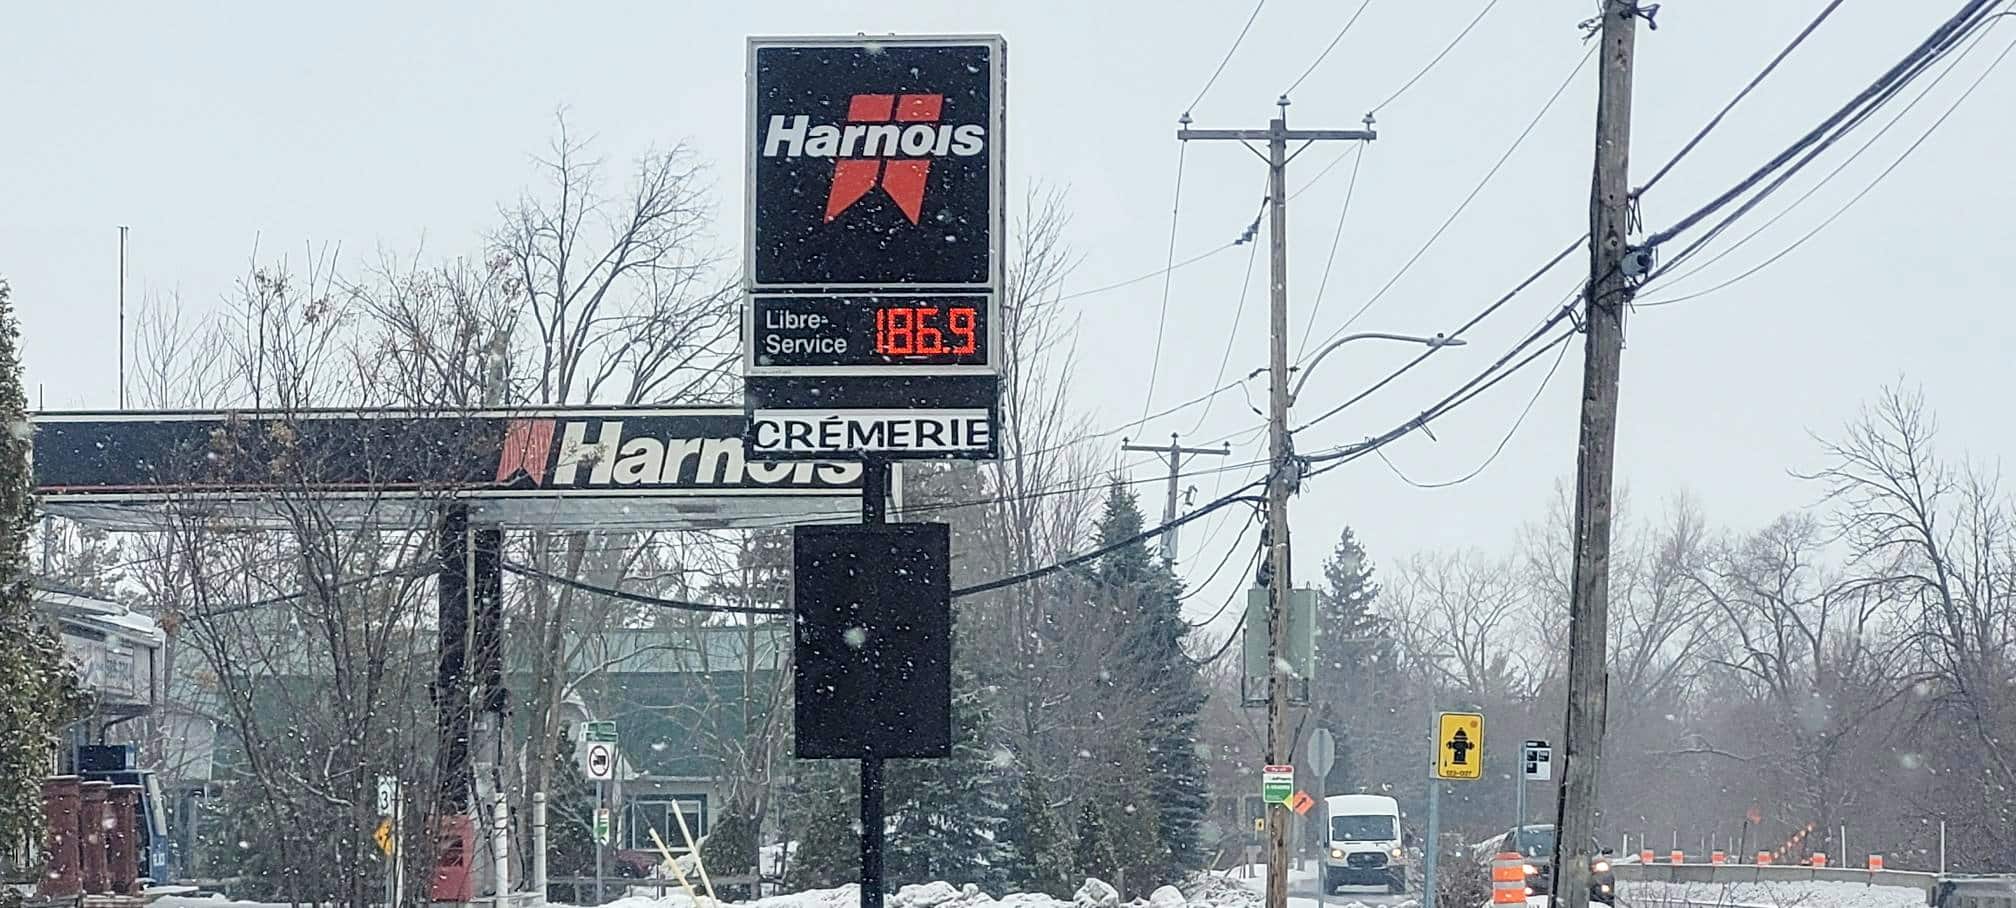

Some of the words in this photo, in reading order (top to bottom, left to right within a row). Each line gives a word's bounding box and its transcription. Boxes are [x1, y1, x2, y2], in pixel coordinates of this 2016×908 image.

[763, 114, 985, 158] Harnois
[766, 334, 848, 355] Service
[876, 308, 976, 354] 186.9
[752, 414, 989, 449] CRÉMERIE
